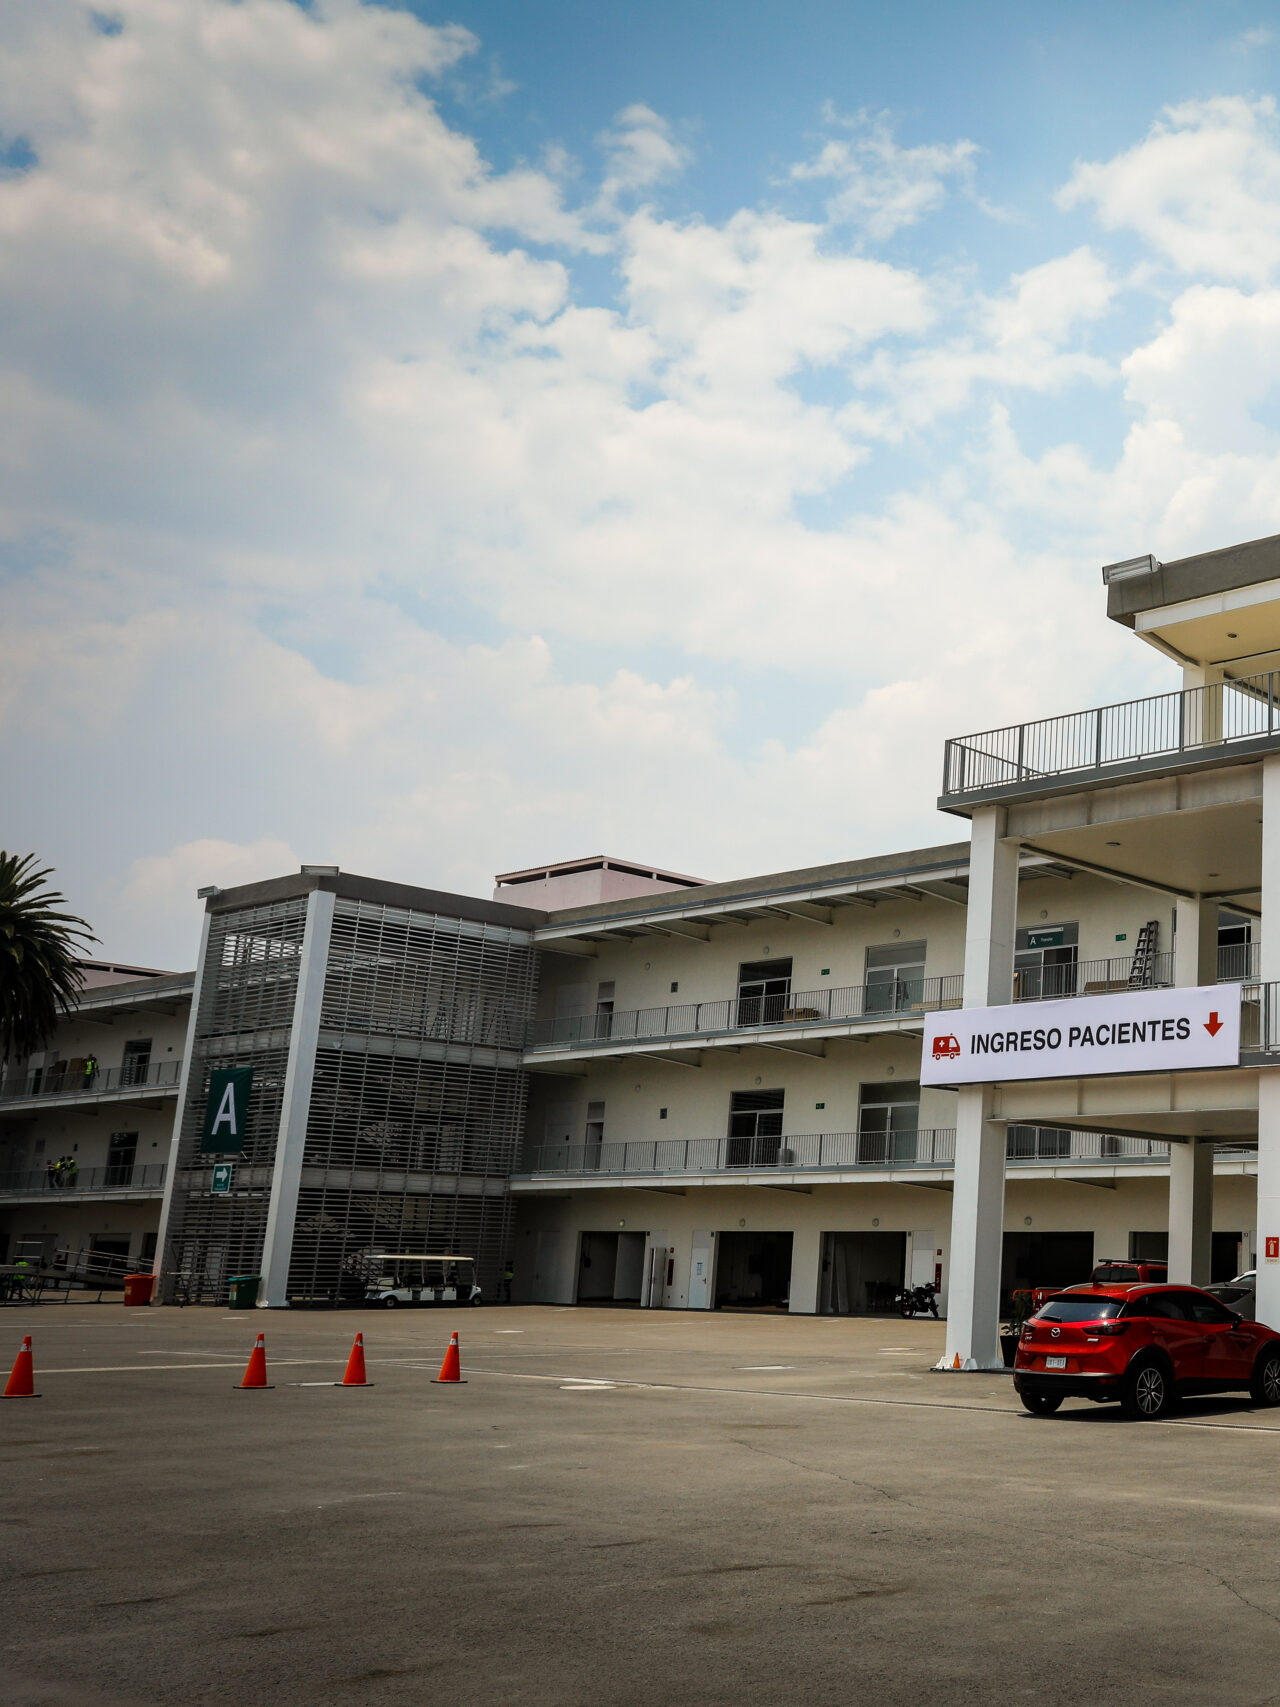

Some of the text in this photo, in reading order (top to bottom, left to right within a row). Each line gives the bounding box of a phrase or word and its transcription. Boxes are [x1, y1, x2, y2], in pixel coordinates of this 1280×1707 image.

[1030, 936, 1037, 946] A
[970, 1017, 1191, 1055] INGRESO PACIENTES
[211, 1082, 237, 1135] A
